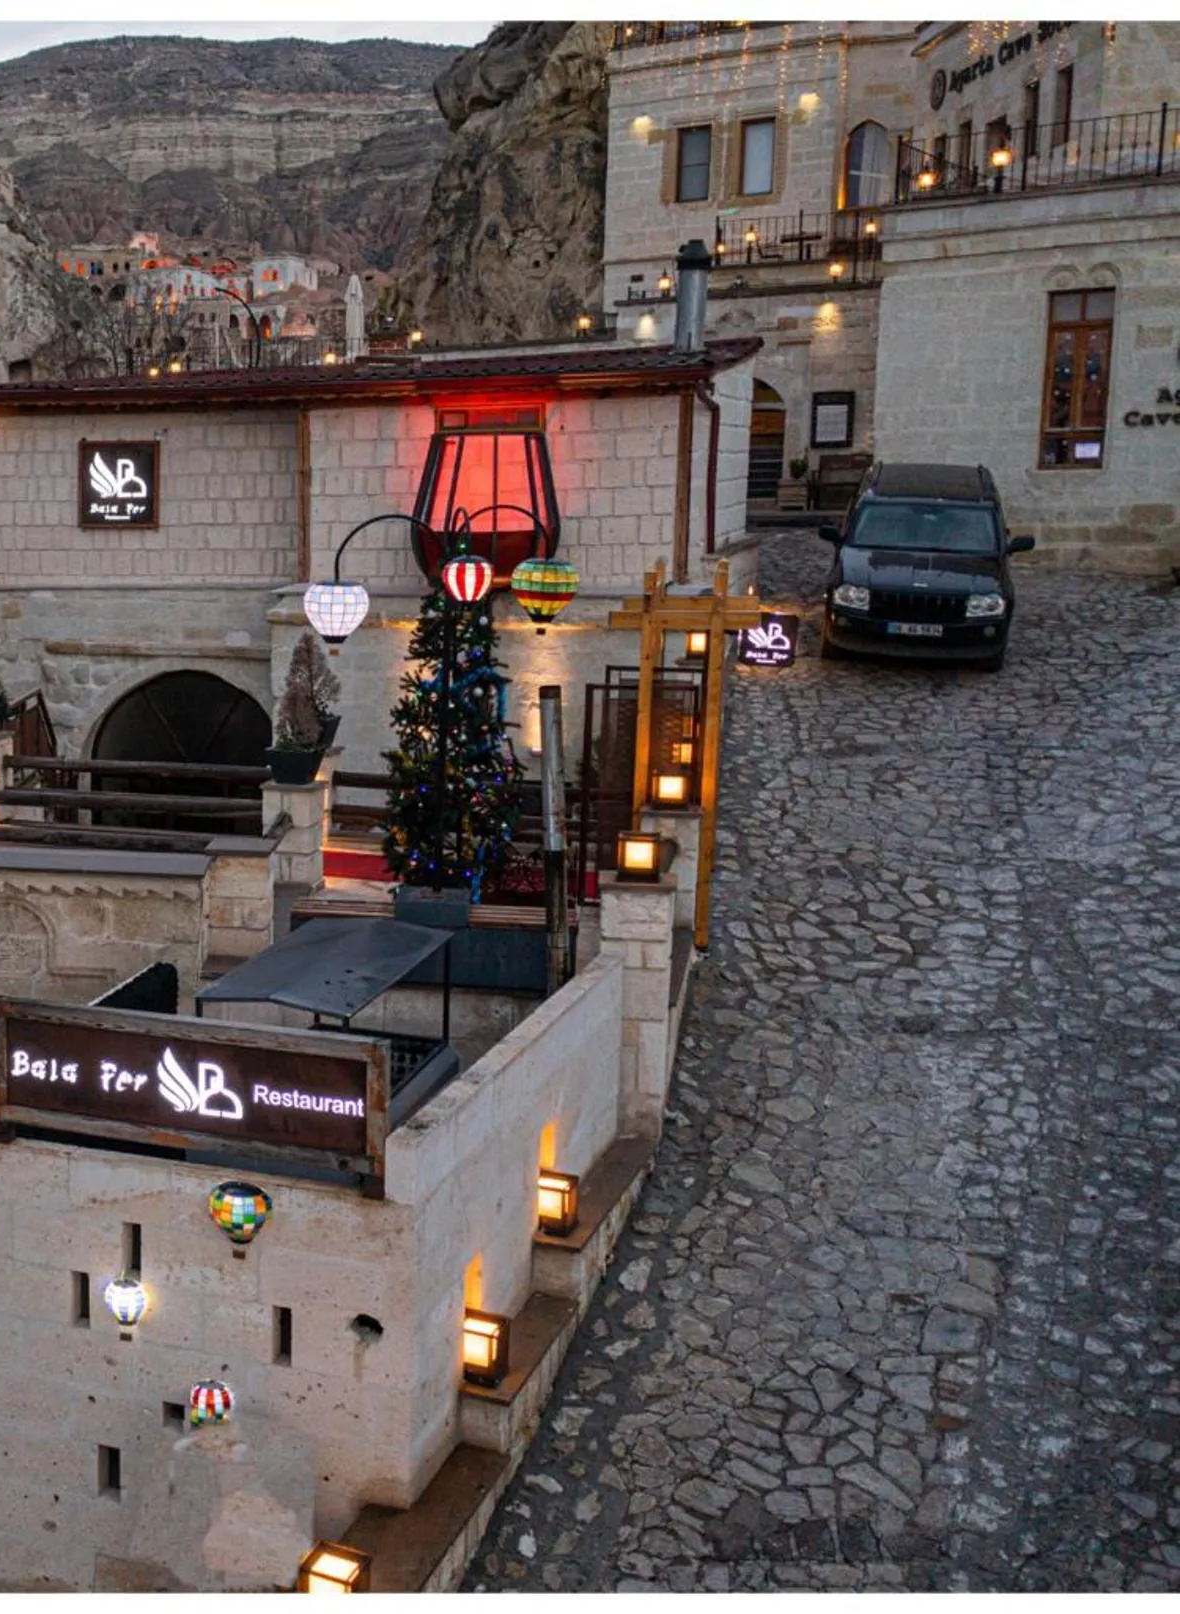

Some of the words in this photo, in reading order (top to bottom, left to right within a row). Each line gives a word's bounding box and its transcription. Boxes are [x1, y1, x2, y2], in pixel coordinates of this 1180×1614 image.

[11, 1051, 79, 1084] Bala
[101, 1060, 147, 1093] Per
[253, 1084, 365, 1118] Restaurant
